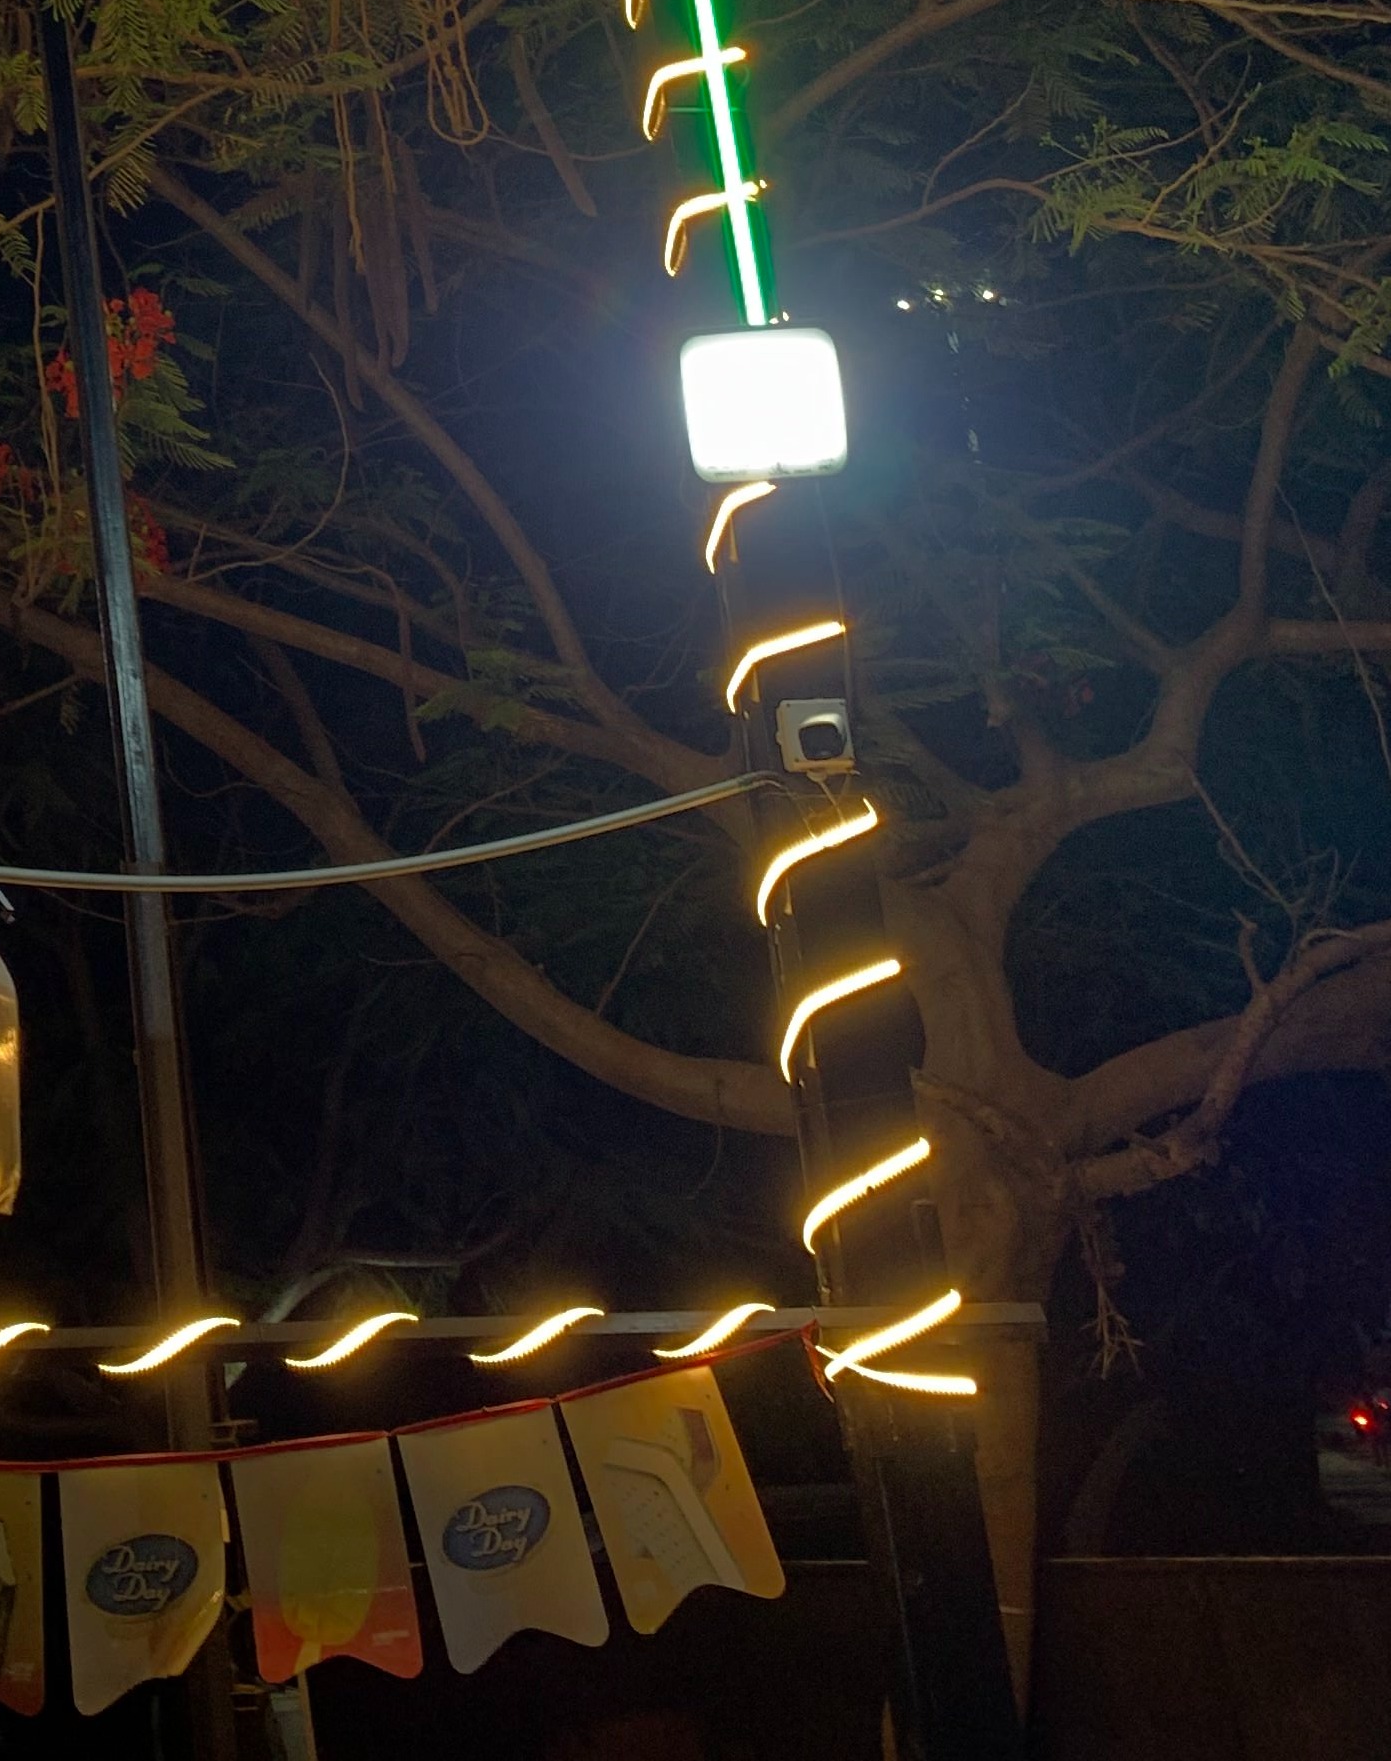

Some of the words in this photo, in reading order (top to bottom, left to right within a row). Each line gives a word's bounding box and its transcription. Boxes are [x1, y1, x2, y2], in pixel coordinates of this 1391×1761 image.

[455, 1501, 532, 1533] Dairy
[470, 1527, 528, 1561] Day
[101, 1545, 179, 1583] Dairy
[112, 1572, 172, 1611] Day
